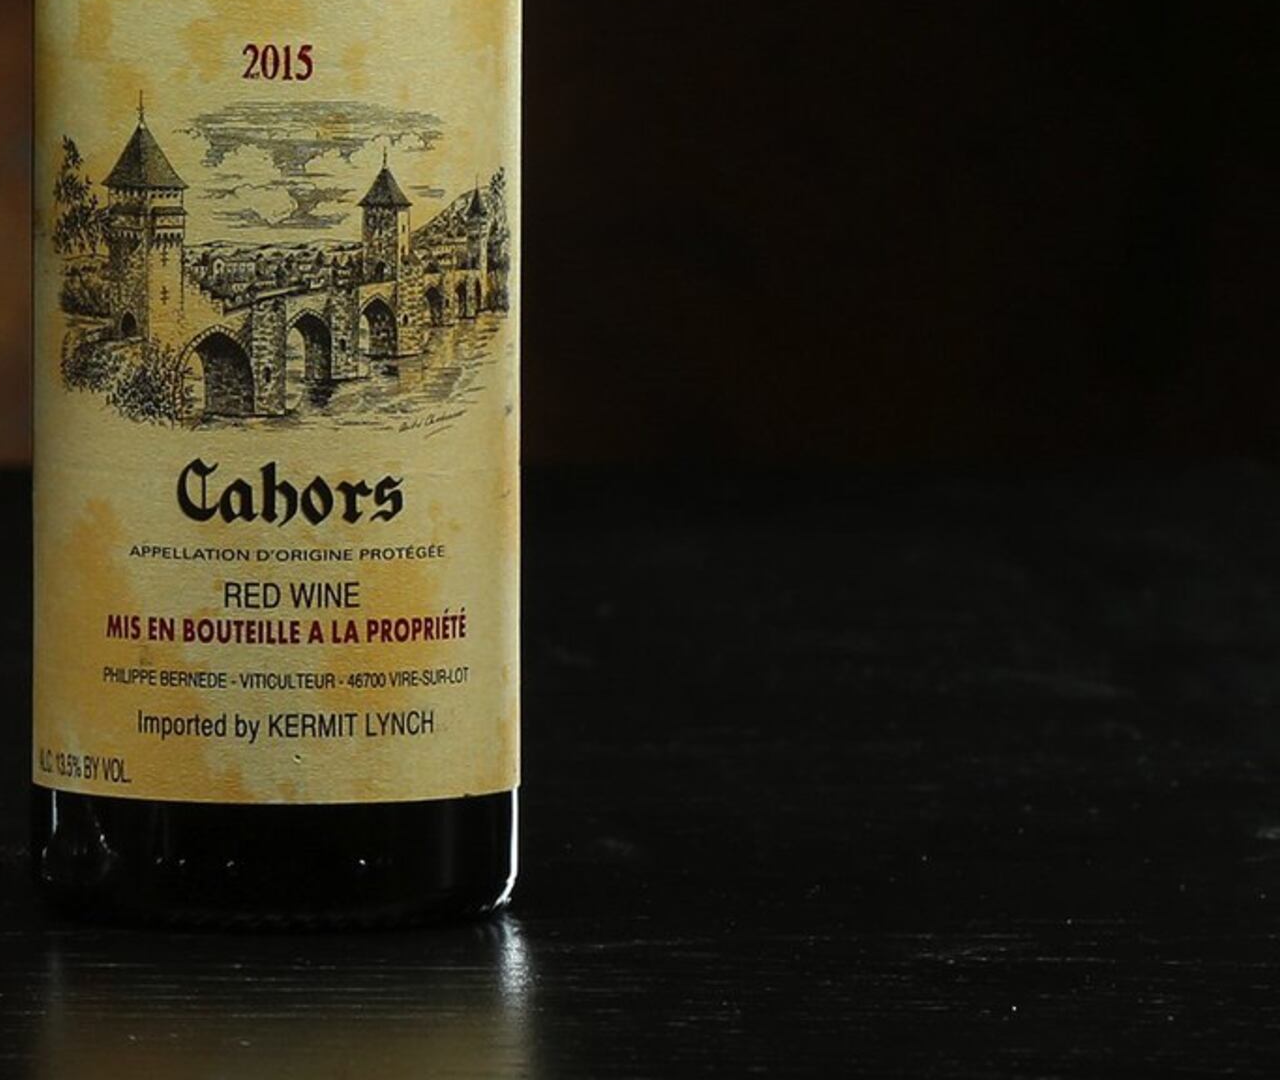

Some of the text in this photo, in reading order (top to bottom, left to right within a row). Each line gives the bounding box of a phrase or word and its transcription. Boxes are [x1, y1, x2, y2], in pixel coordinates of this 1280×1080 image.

[242, 44, 314, 80] 2015
[177, 458, 404, 528] Cahors
[130, 543, 445, 561] APPELLATION D'ORIGINE PROTÉGÉE
[224, 582, 361, 608] RED WINE
[107, 607, 467, 645] MIS EN BOUTEILLE A LA PROPRIÉTÉ
[103, 667, 157, 685] PHILIPPE
[160, 670, 227, 688] BERNEDE
[240, 672, 336, 689] VITICULTEUR
[347, 672, 386, 688] 46700
[389, 666, 470, 687] VIRE-SUR-LOT
[138, 709, 434, 744] Imported by KERMIT LYNCH
[83, 755, 99, 780] BY
